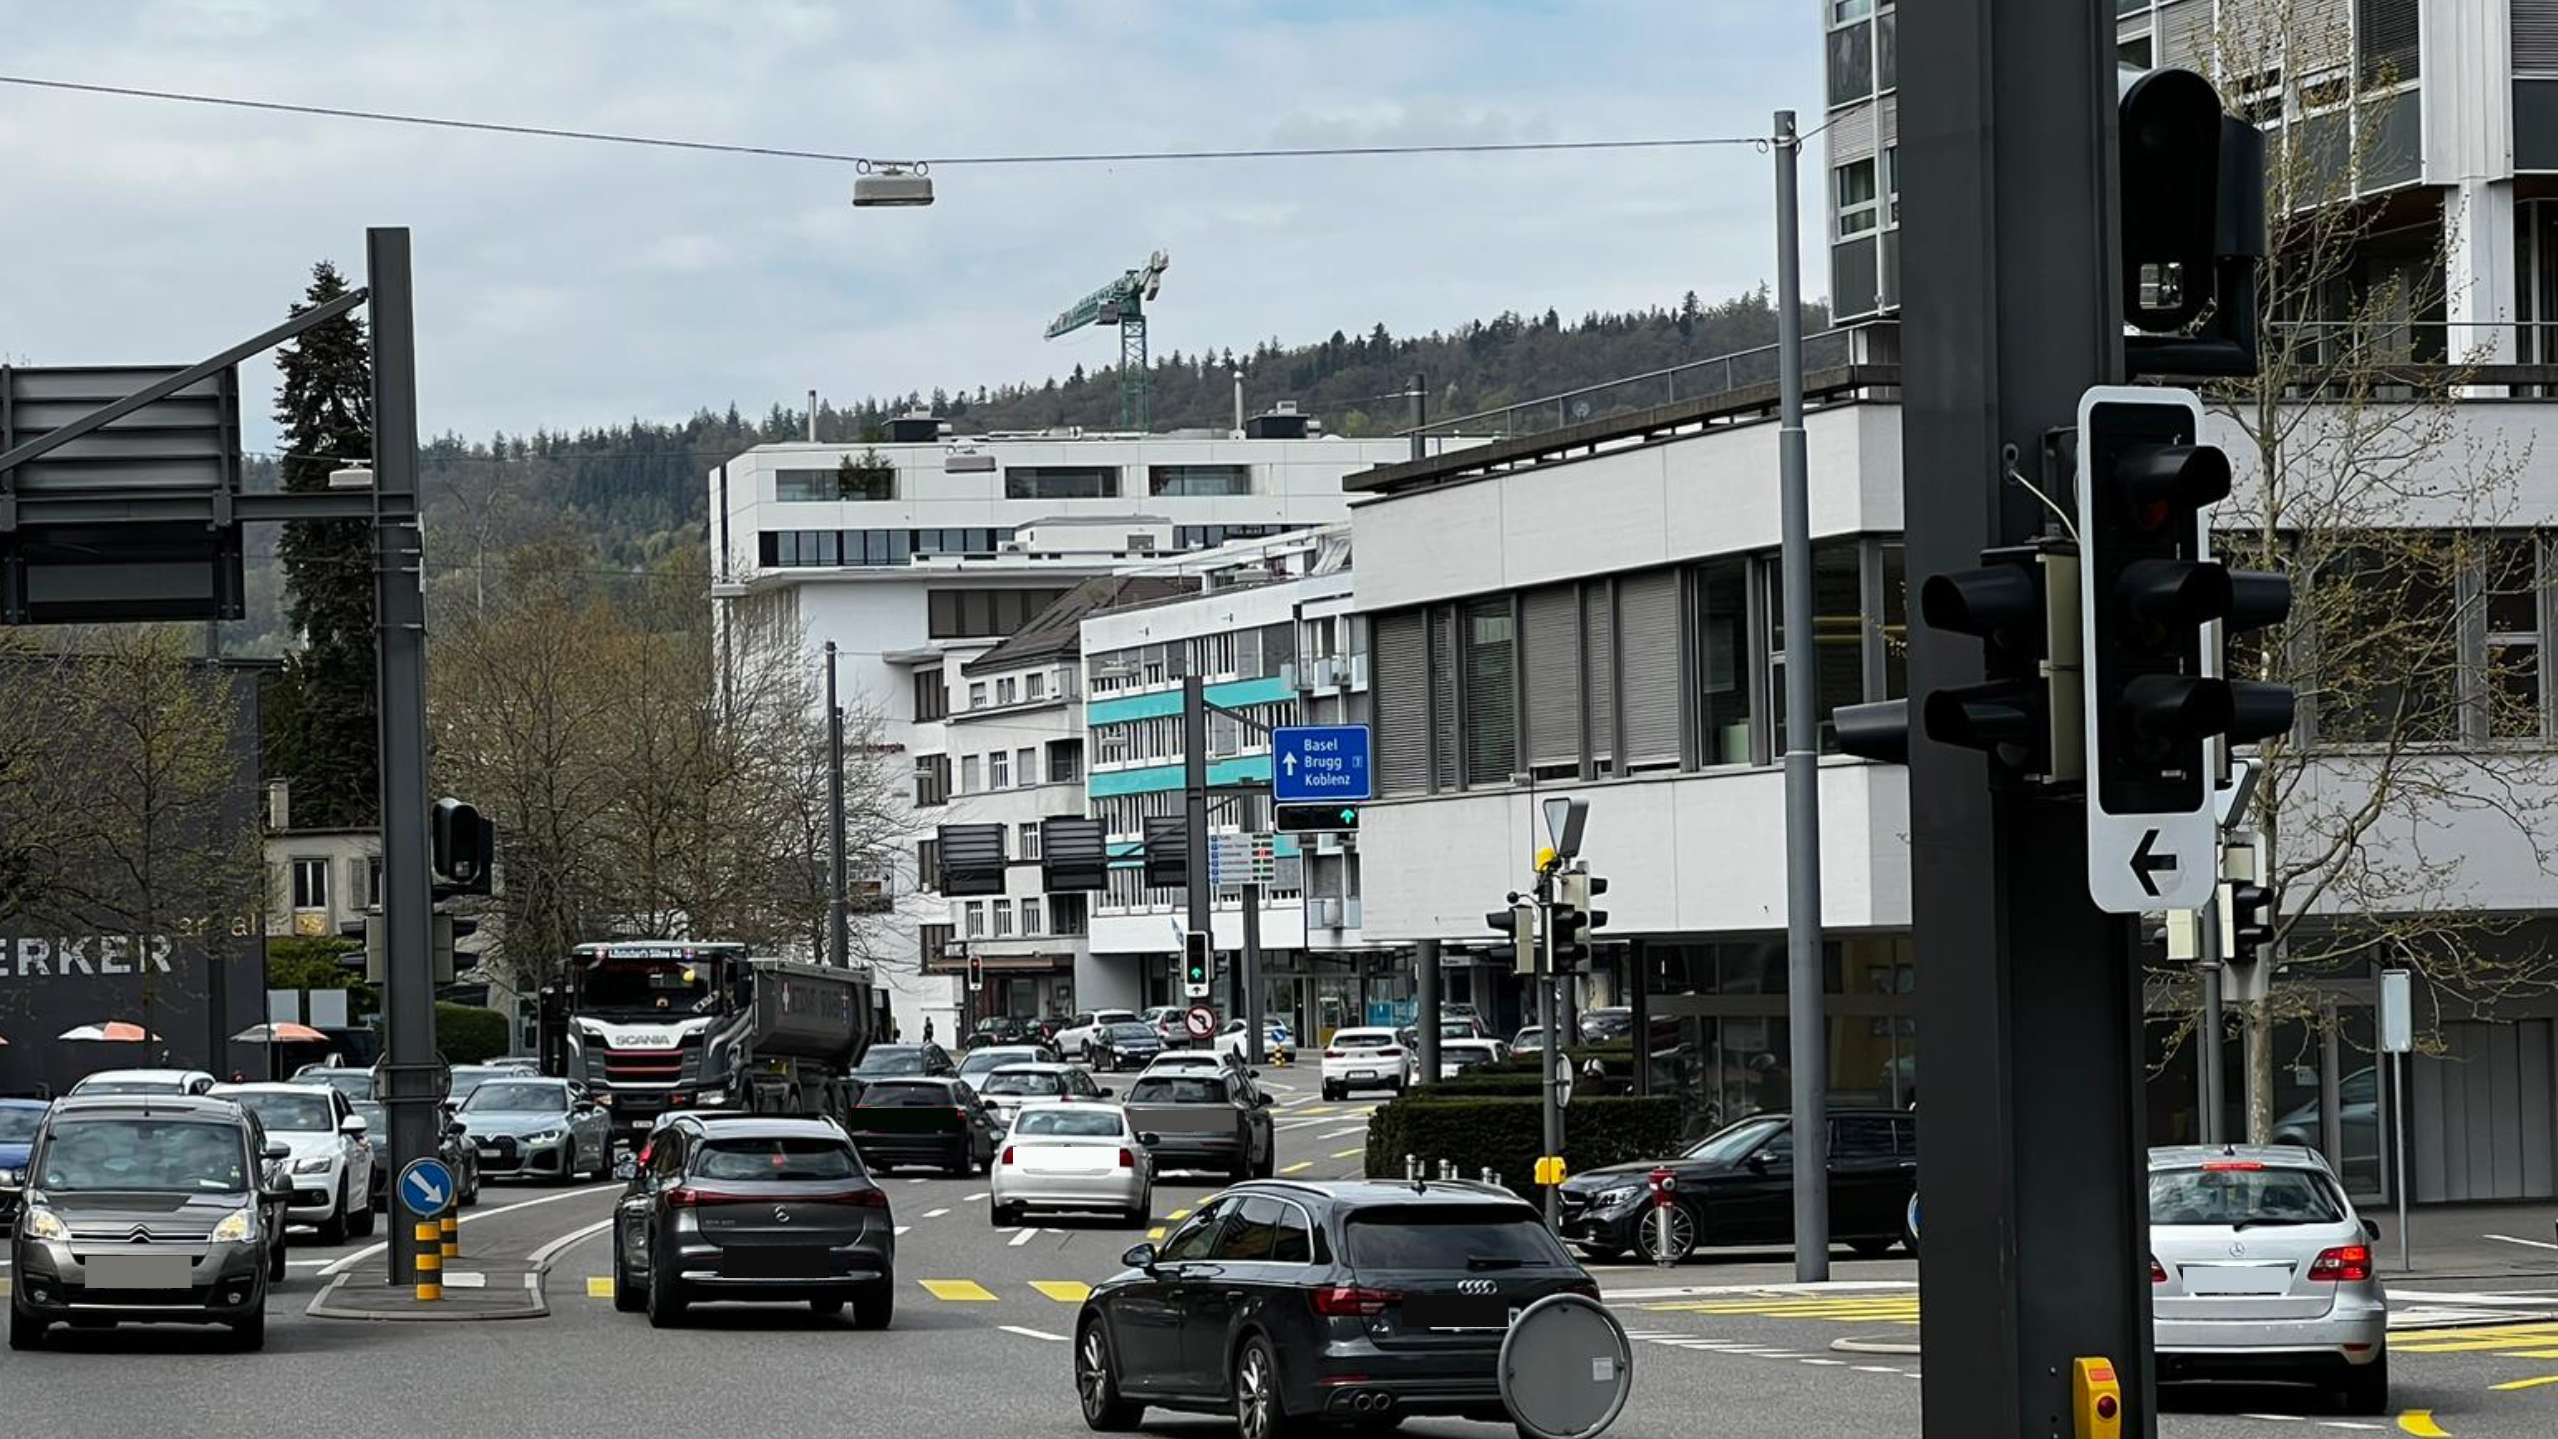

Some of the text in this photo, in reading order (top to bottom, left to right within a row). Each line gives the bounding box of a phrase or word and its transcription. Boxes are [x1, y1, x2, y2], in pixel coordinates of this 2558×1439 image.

[1304, 738, 1338, 751] Basel
[1304, 755, 1342, 771] Brugg
[1305, 773, 1350, 786] Koblenz
[615, 1034, 670, 1045] SCANIA
